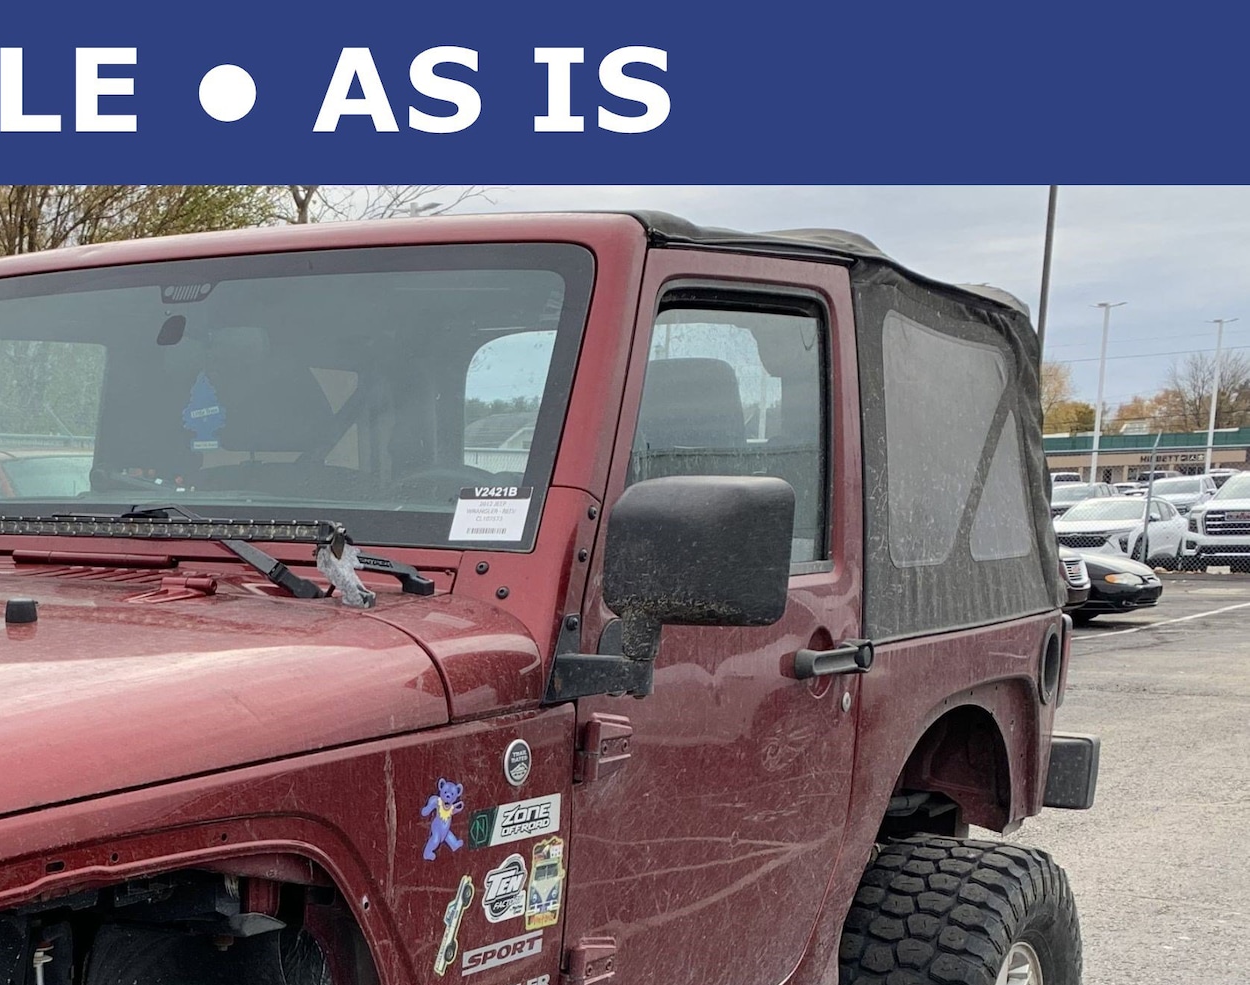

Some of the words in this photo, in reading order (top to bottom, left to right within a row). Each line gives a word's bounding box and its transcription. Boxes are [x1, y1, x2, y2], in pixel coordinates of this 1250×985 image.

[474, 486, 518, 497] V2421B
[502, 802, 551, 827] ZONE
[501, 818, 550, 837] OFFROAD
[485, 867, 525, 902] TEN
[463, 935, 543, 970] SPORT
